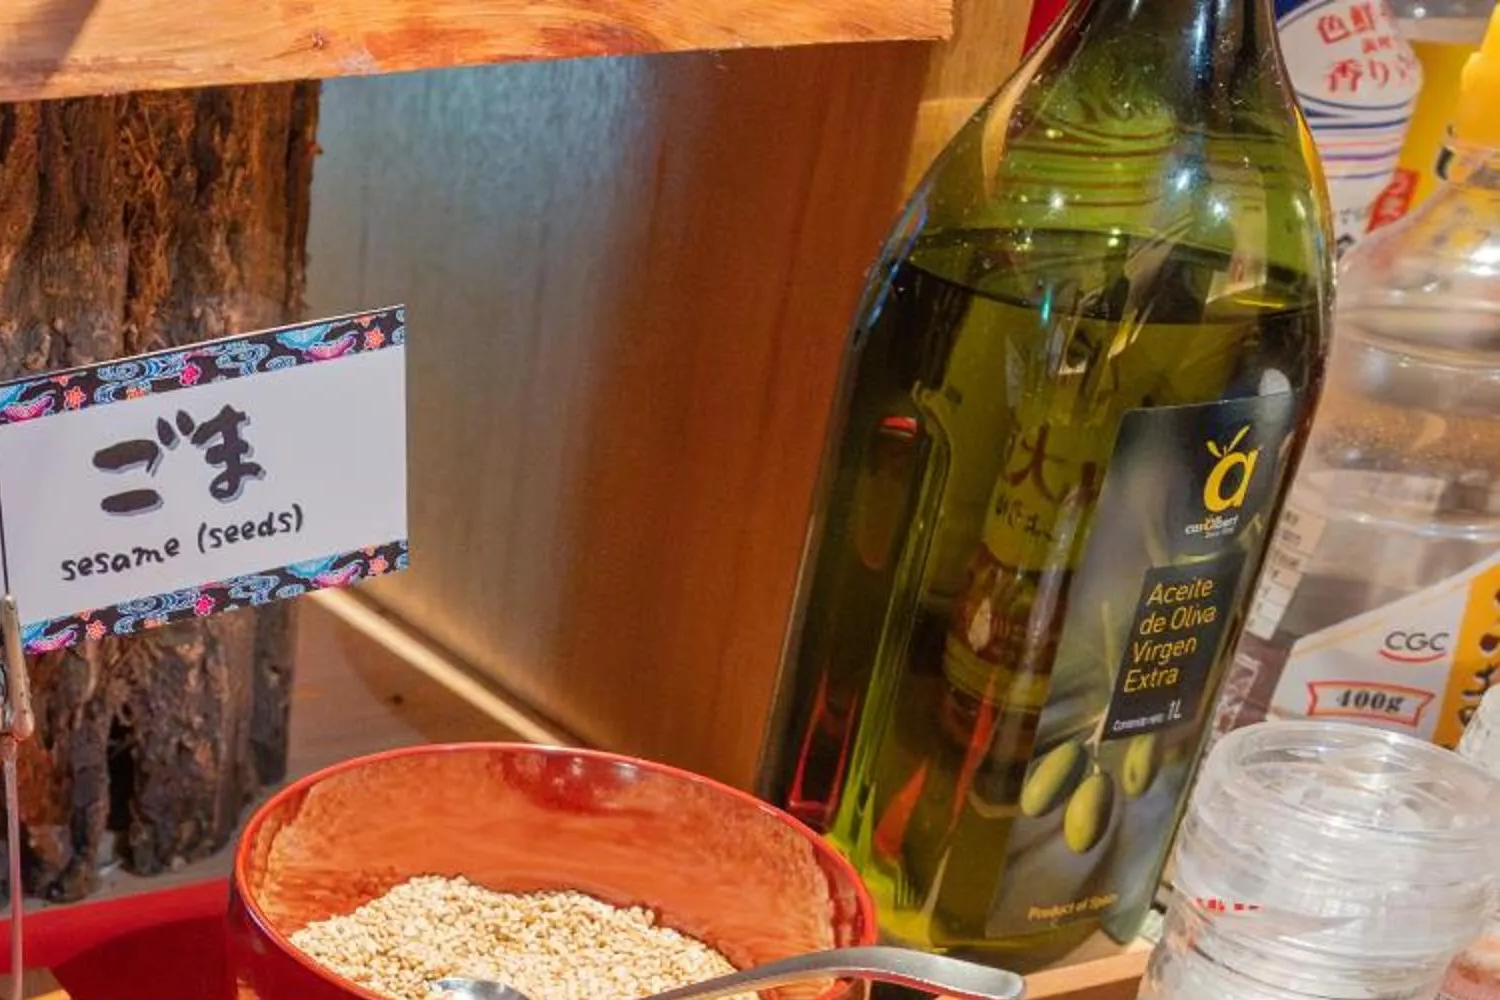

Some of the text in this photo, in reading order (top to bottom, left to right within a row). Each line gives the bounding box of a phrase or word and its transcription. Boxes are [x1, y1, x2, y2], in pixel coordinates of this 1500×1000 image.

[92, 404, 264, 515] ごま
[60, 502, 304, 582] sesame (seeds)
[1146, 576, 1214, 606] Aceite
[1139, 611, 1167, 635] de
[1130, 635, 1198, 666] Virgen
[1384, 631, 1450, 652] CGC
[1122, 666, 1181, 693] Extra
[1336, 690, 1405, 713] 400g
